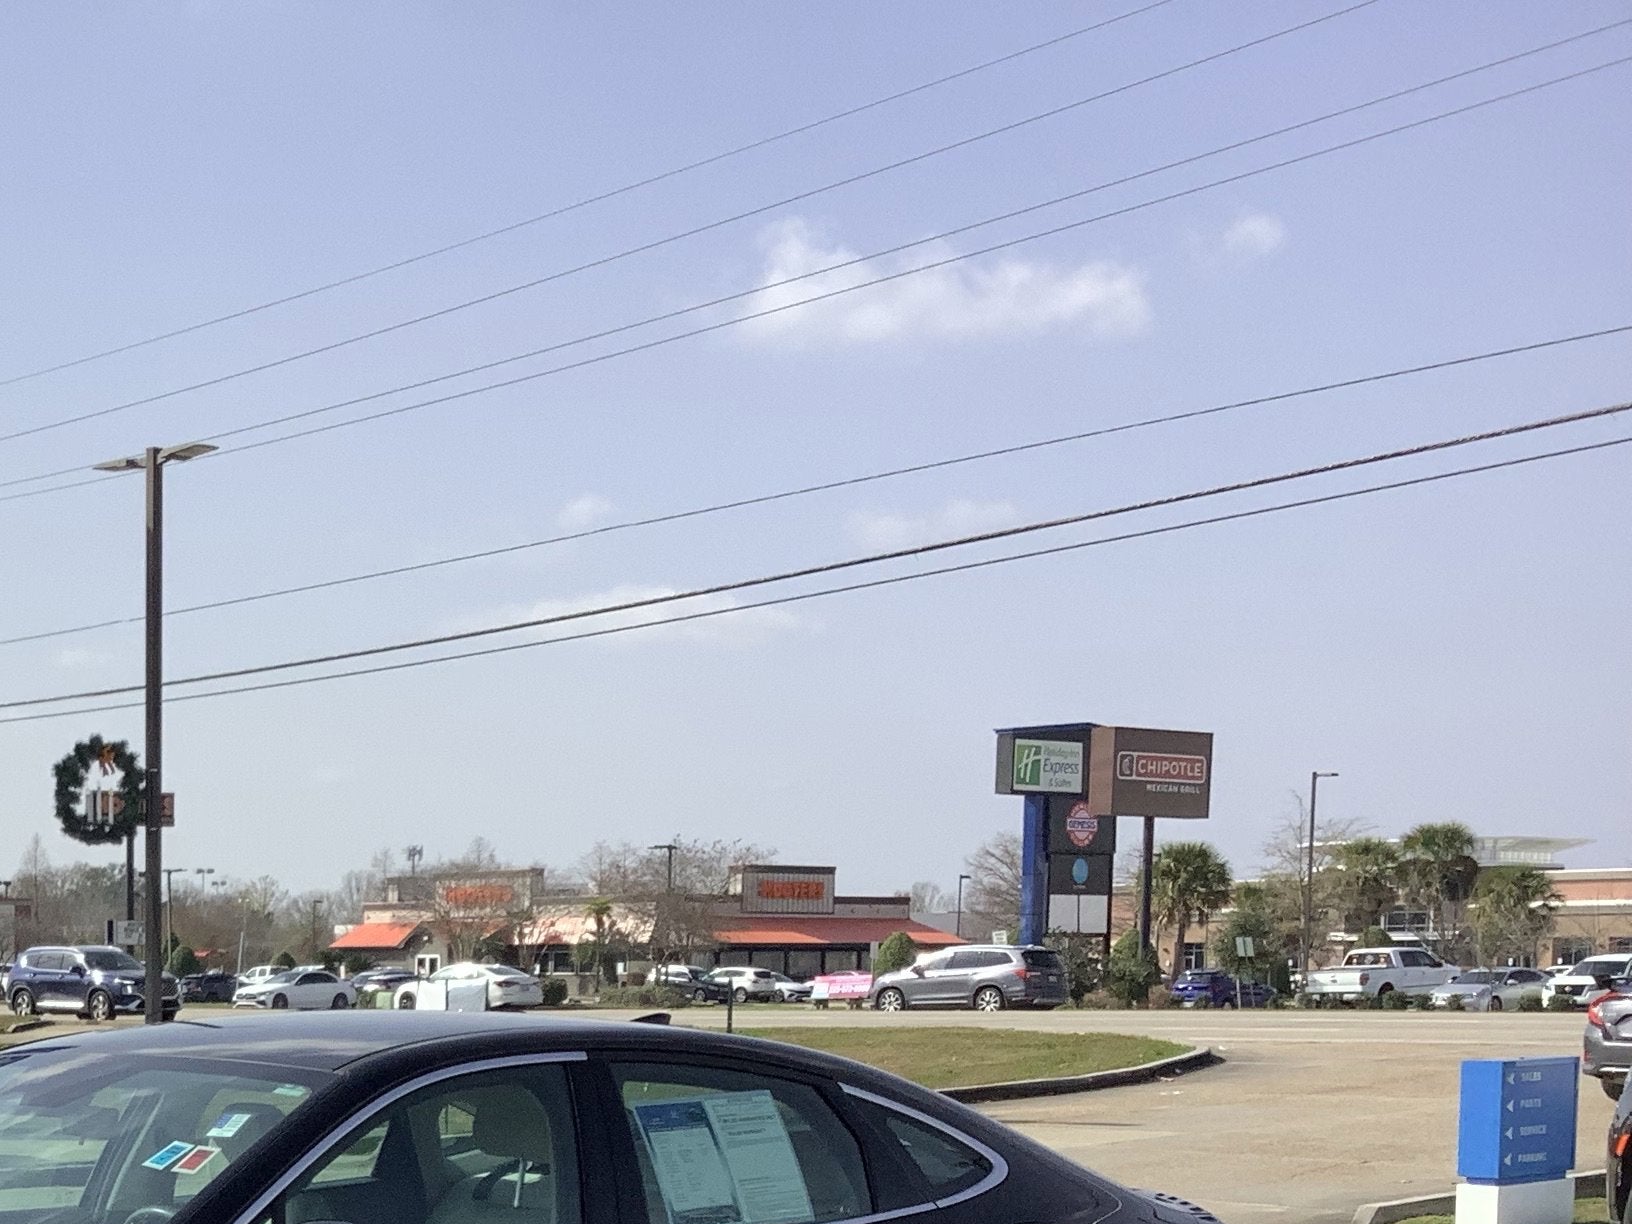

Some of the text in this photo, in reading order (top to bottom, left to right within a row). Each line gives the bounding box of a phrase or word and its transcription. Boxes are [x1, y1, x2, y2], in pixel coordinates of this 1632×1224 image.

[1043, 758, 1079, 775] Express
[1137, 759, 1202, 777] CHIPOTLE
[1147, 784, 1200, 794] MEXICAN GRILL
[1068, 820, 1096, 829] GENESIS
